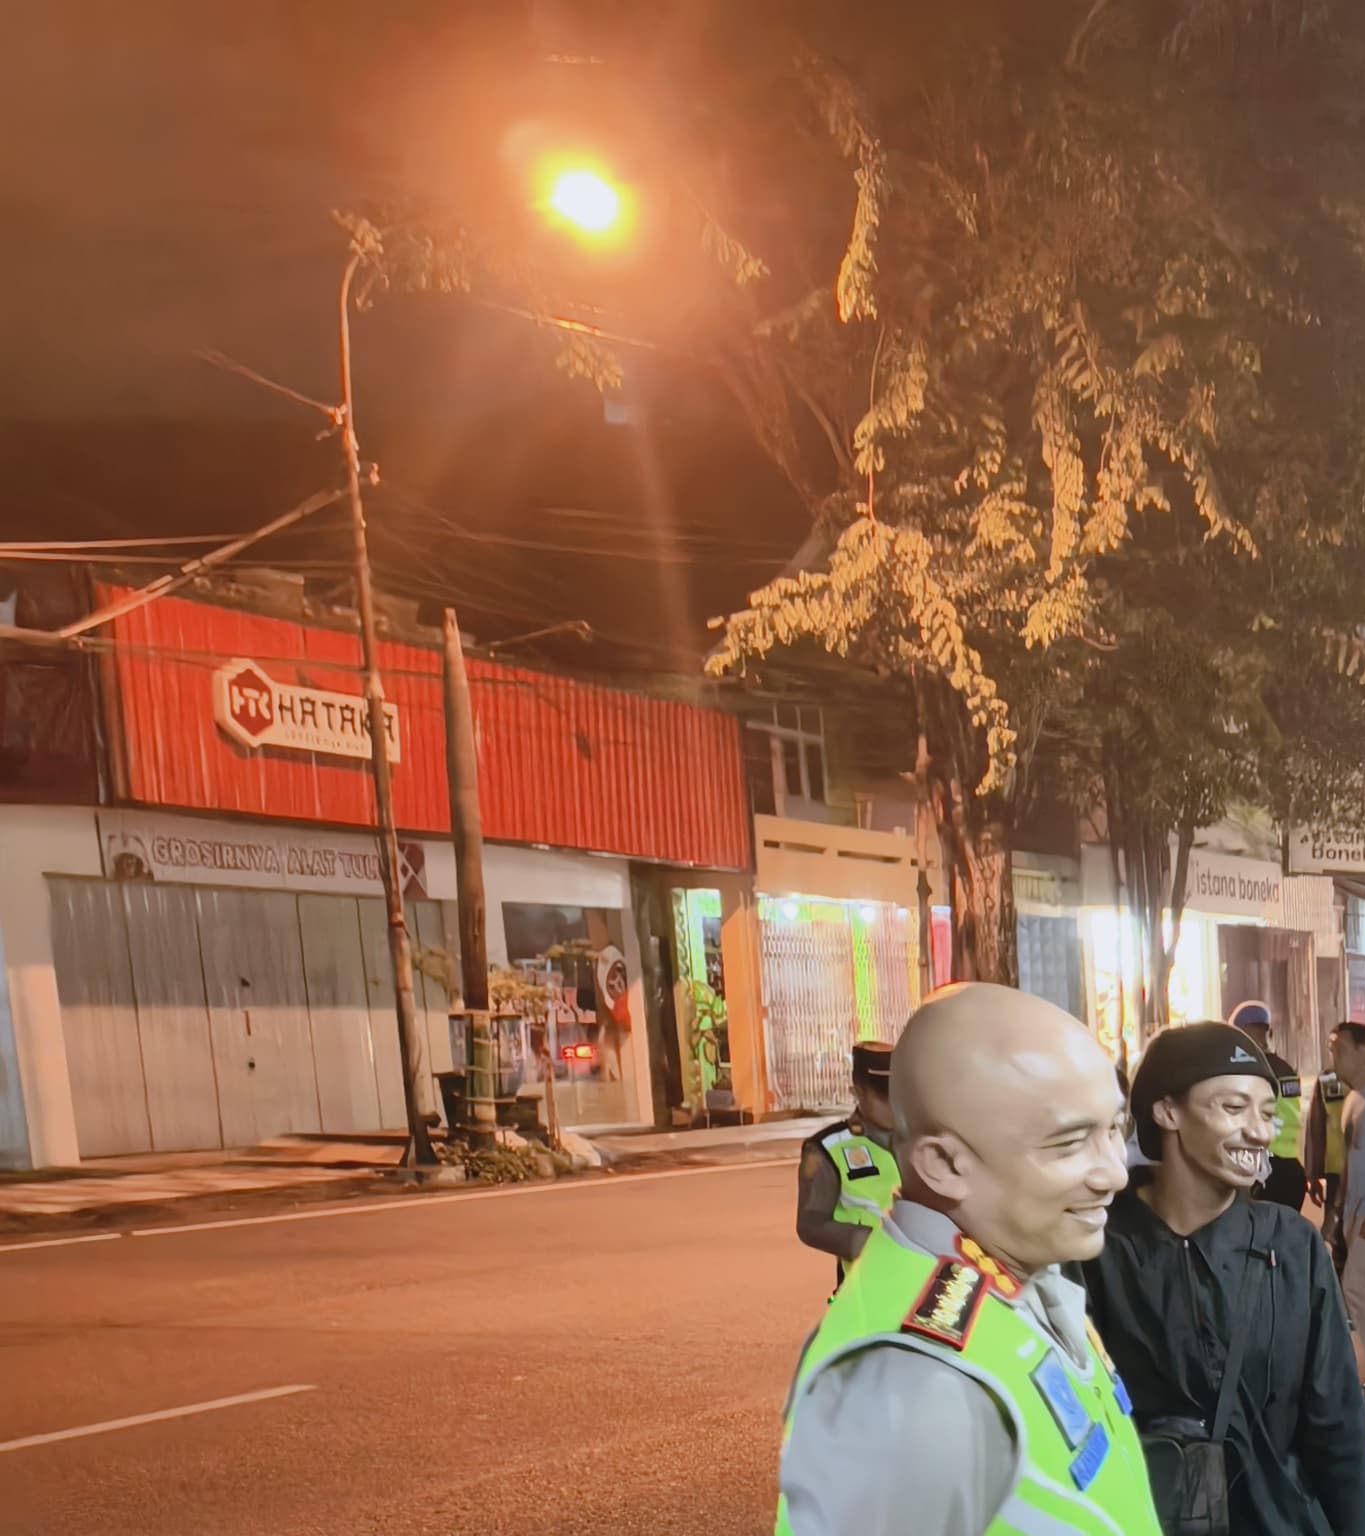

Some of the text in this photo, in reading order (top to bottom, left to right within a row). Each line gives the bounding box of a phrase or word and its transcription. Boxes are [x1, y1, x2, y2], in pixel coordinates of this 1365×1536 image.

[151, 836, 282, 874] GROSIRNYA
[287, 847, 337, 877] ALAT
[1195, 859, 1280, 903] istana boneka
